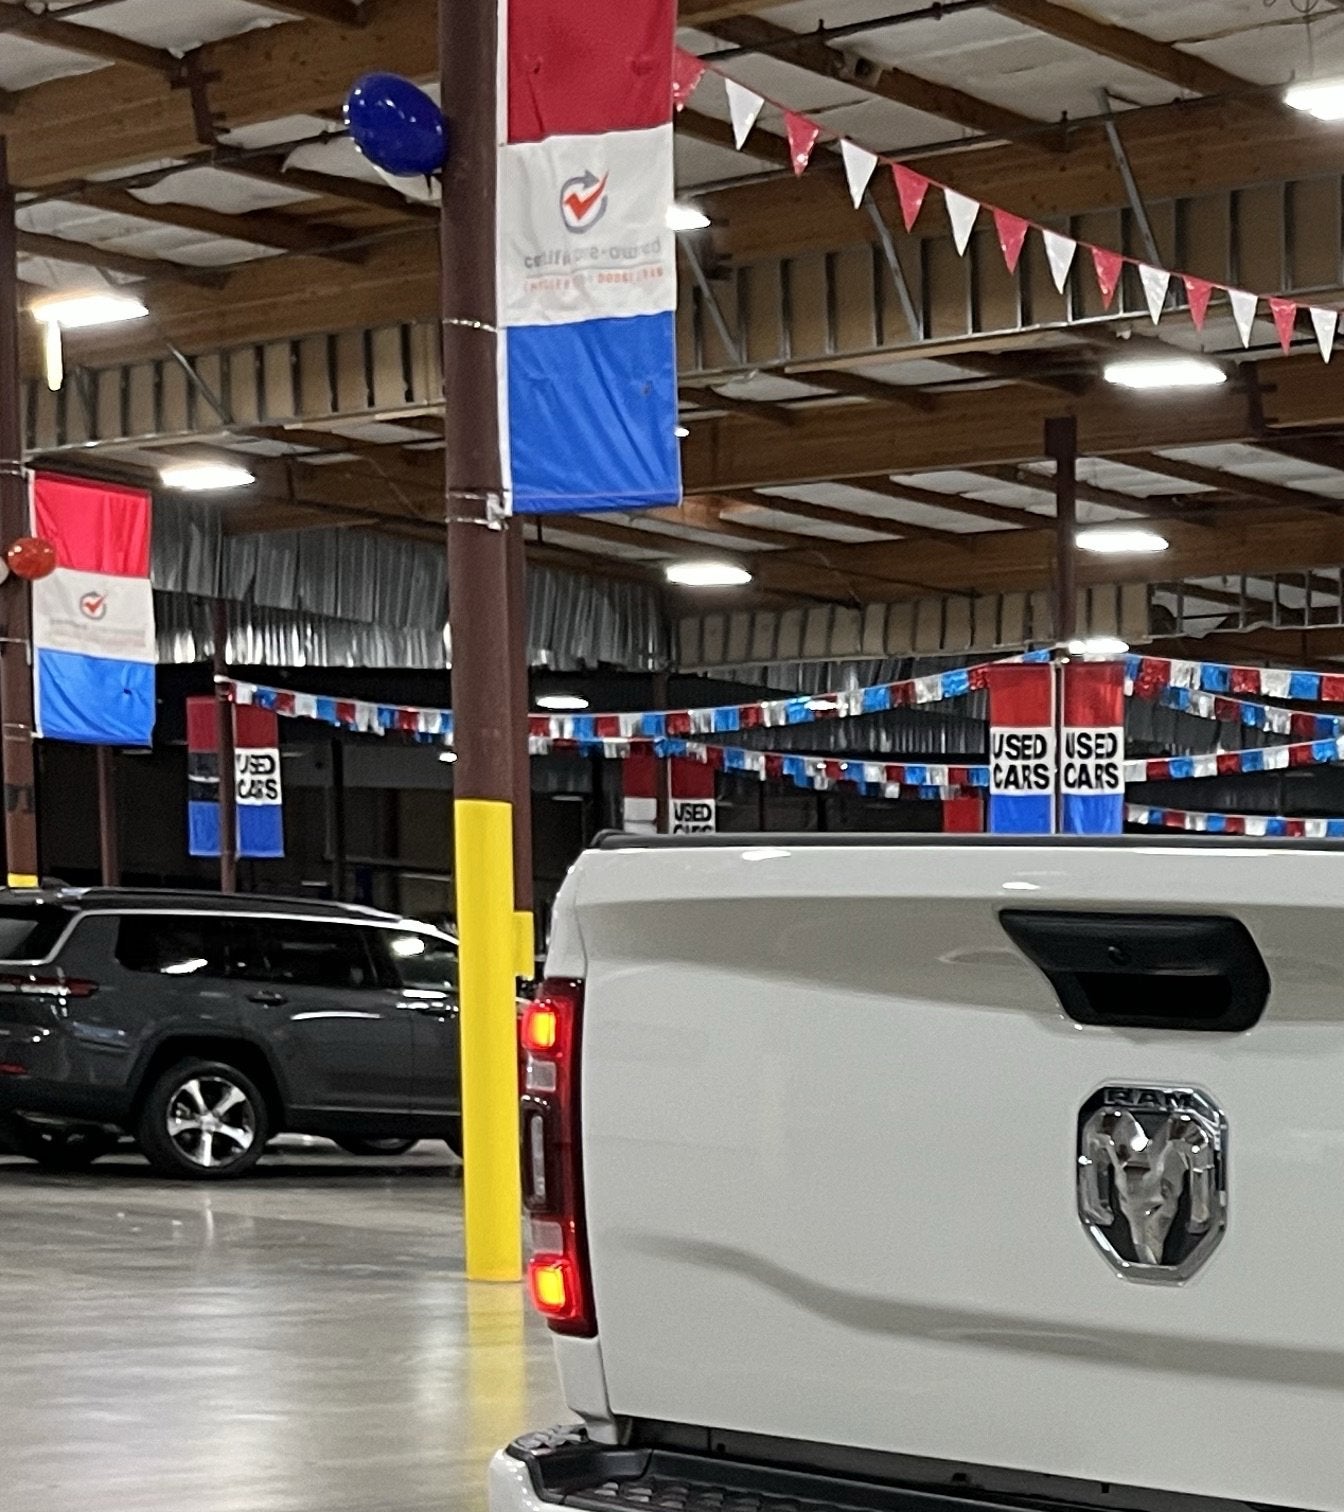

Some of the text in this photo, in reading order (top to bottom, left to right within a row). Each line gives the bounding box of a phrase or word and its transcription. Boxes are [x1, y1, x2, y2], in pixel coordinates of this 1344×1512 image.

[993, 733, 1047, 760] USED
[1065, 732, 1118, 760] USED
[993, 763, 1050, 790] CARS
[1064, 762, 1119, 789] CARS
[1104, 1088, 1193, 1111] RAM
